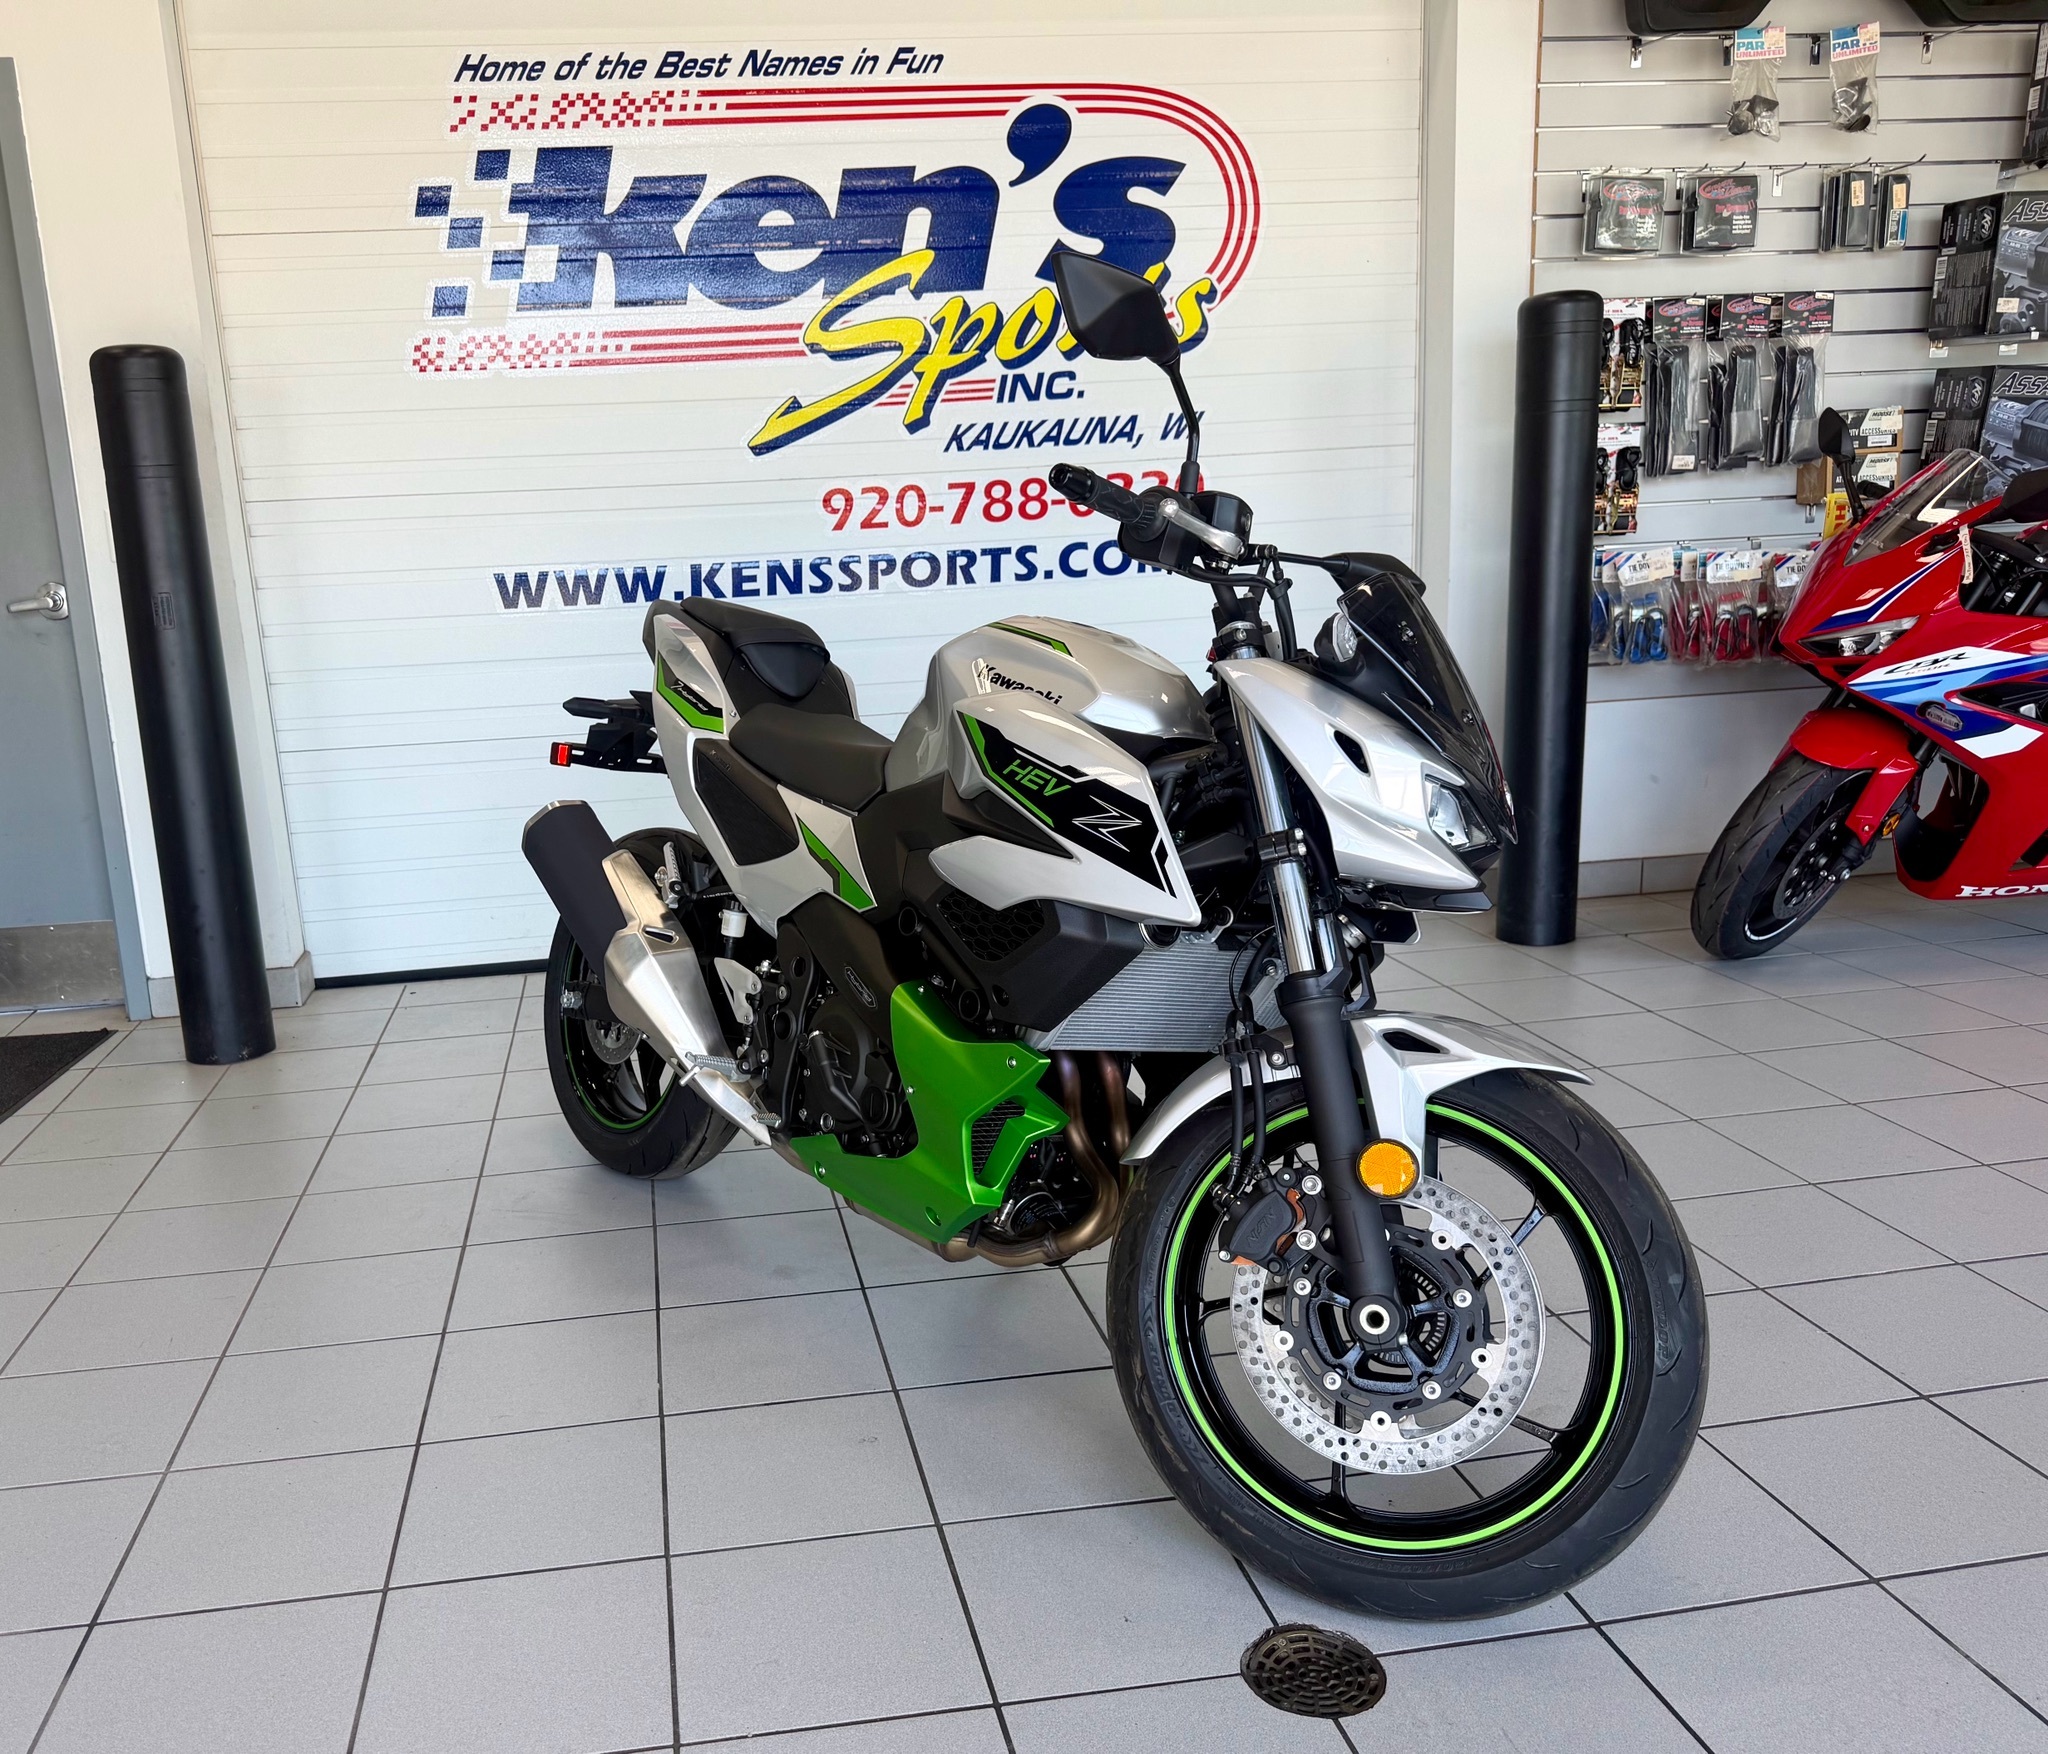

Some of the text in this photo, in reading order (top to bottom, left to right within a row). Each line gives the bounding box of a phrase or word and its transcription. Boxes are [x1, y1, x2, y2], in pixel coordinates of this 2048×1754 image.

[454, 46, 944, 82] Home of the Best Names in Fun
[1736, 49, 1785, 59] UNLIMITED
[1832, 45, 1878, 60] UNLIMITED
[997, 371, 1084, 403] INC.
[943, 414, 1143, 453] KAUKAUNA,
[1002, 759, 1071, 797] HEV
